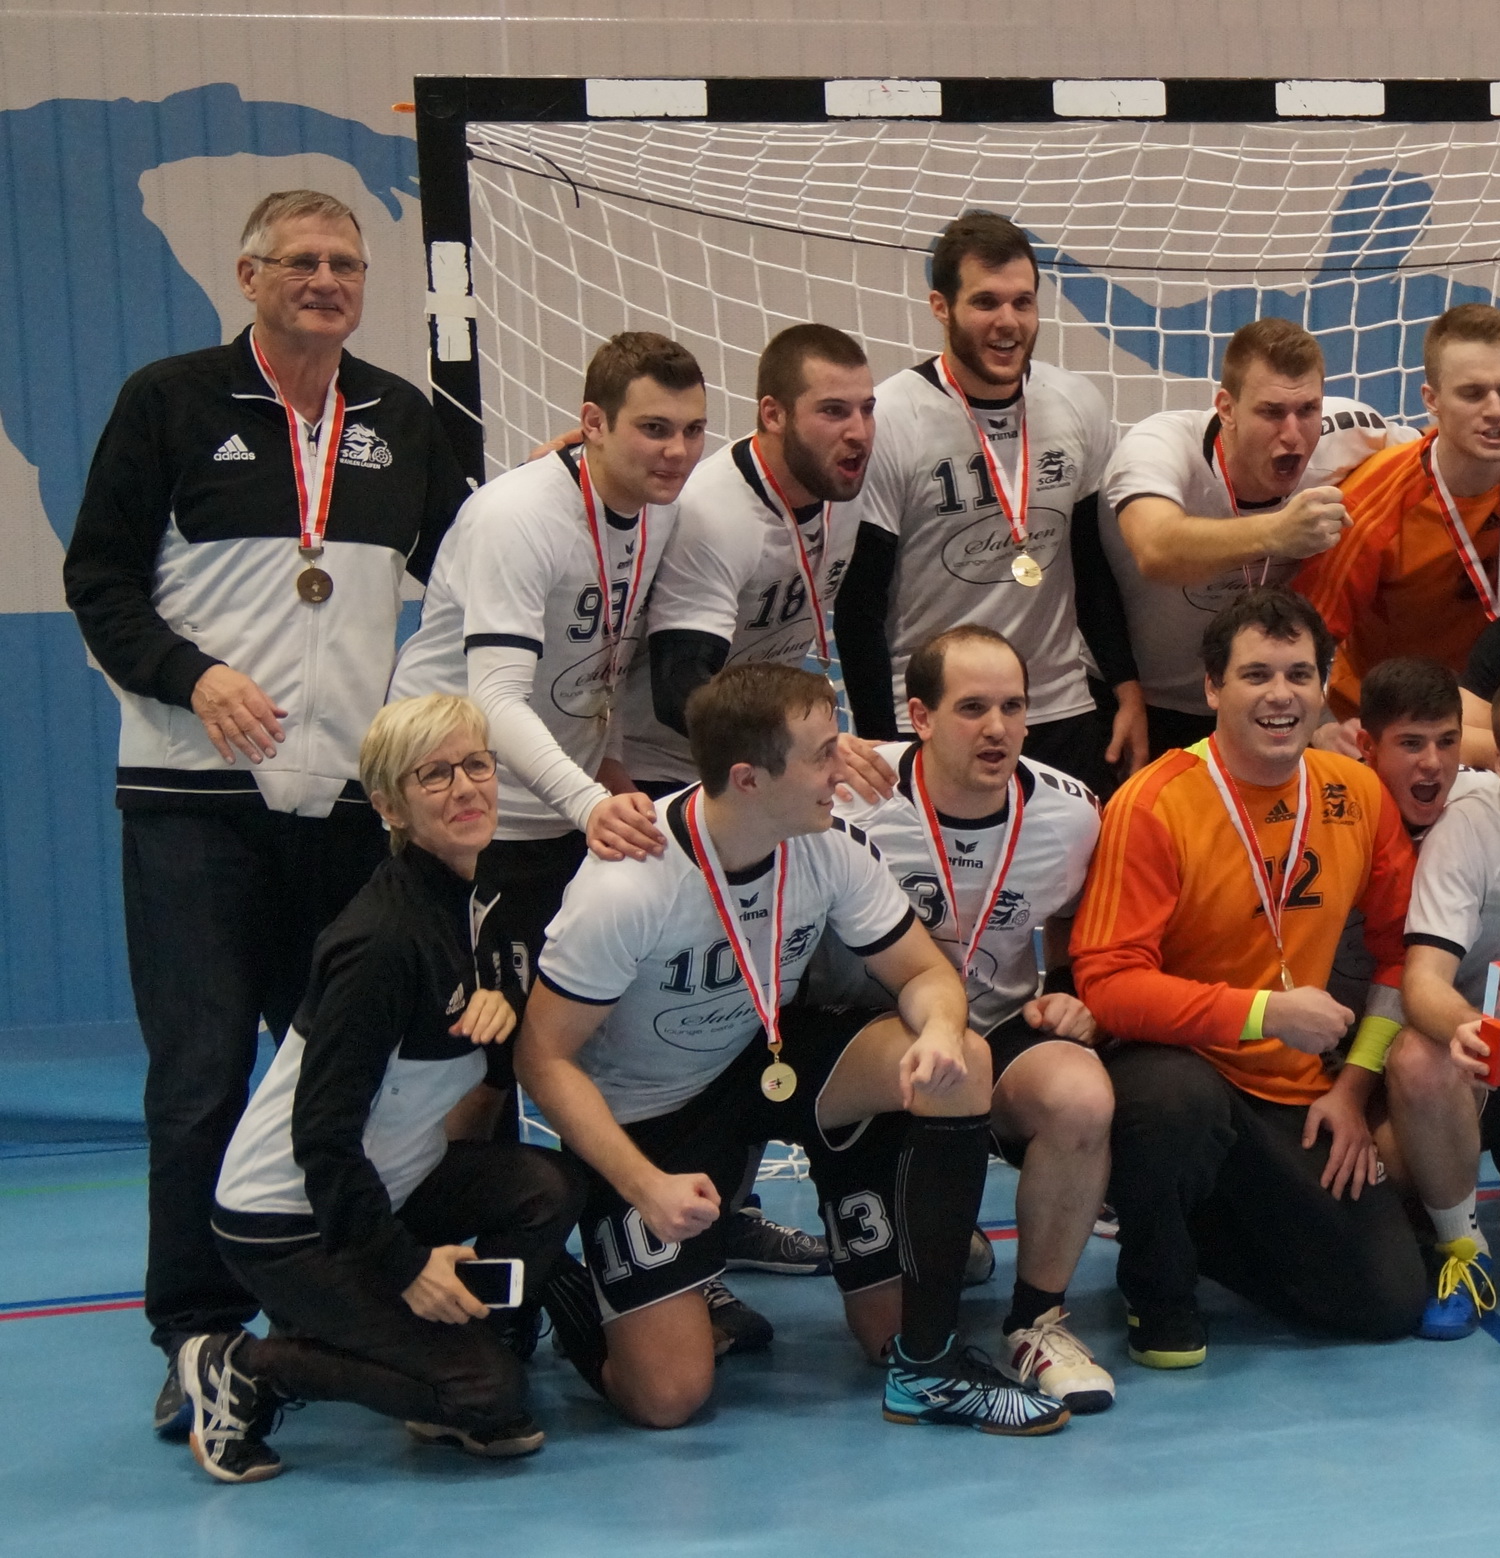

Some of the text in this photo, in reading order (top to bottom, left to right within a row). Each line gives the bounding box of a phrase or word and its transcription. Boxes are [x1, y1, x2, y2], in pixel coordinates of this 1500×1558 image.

[213, 452, 256, 461] adidas
[339, 457, 381, 470] WAHLEN LAUFEN
[340, 449, 363, 460] SG
[931, 451, 1001, 516] 11
[744, 571, 806, 632] 18
[948, 856, 984, 869] rima
[739, 908, 769, 922] rima
[660, 937, 751, 995] 10
[824, 1190, 894, 1263] 13
[595, 1206, 681, 1285] 10
